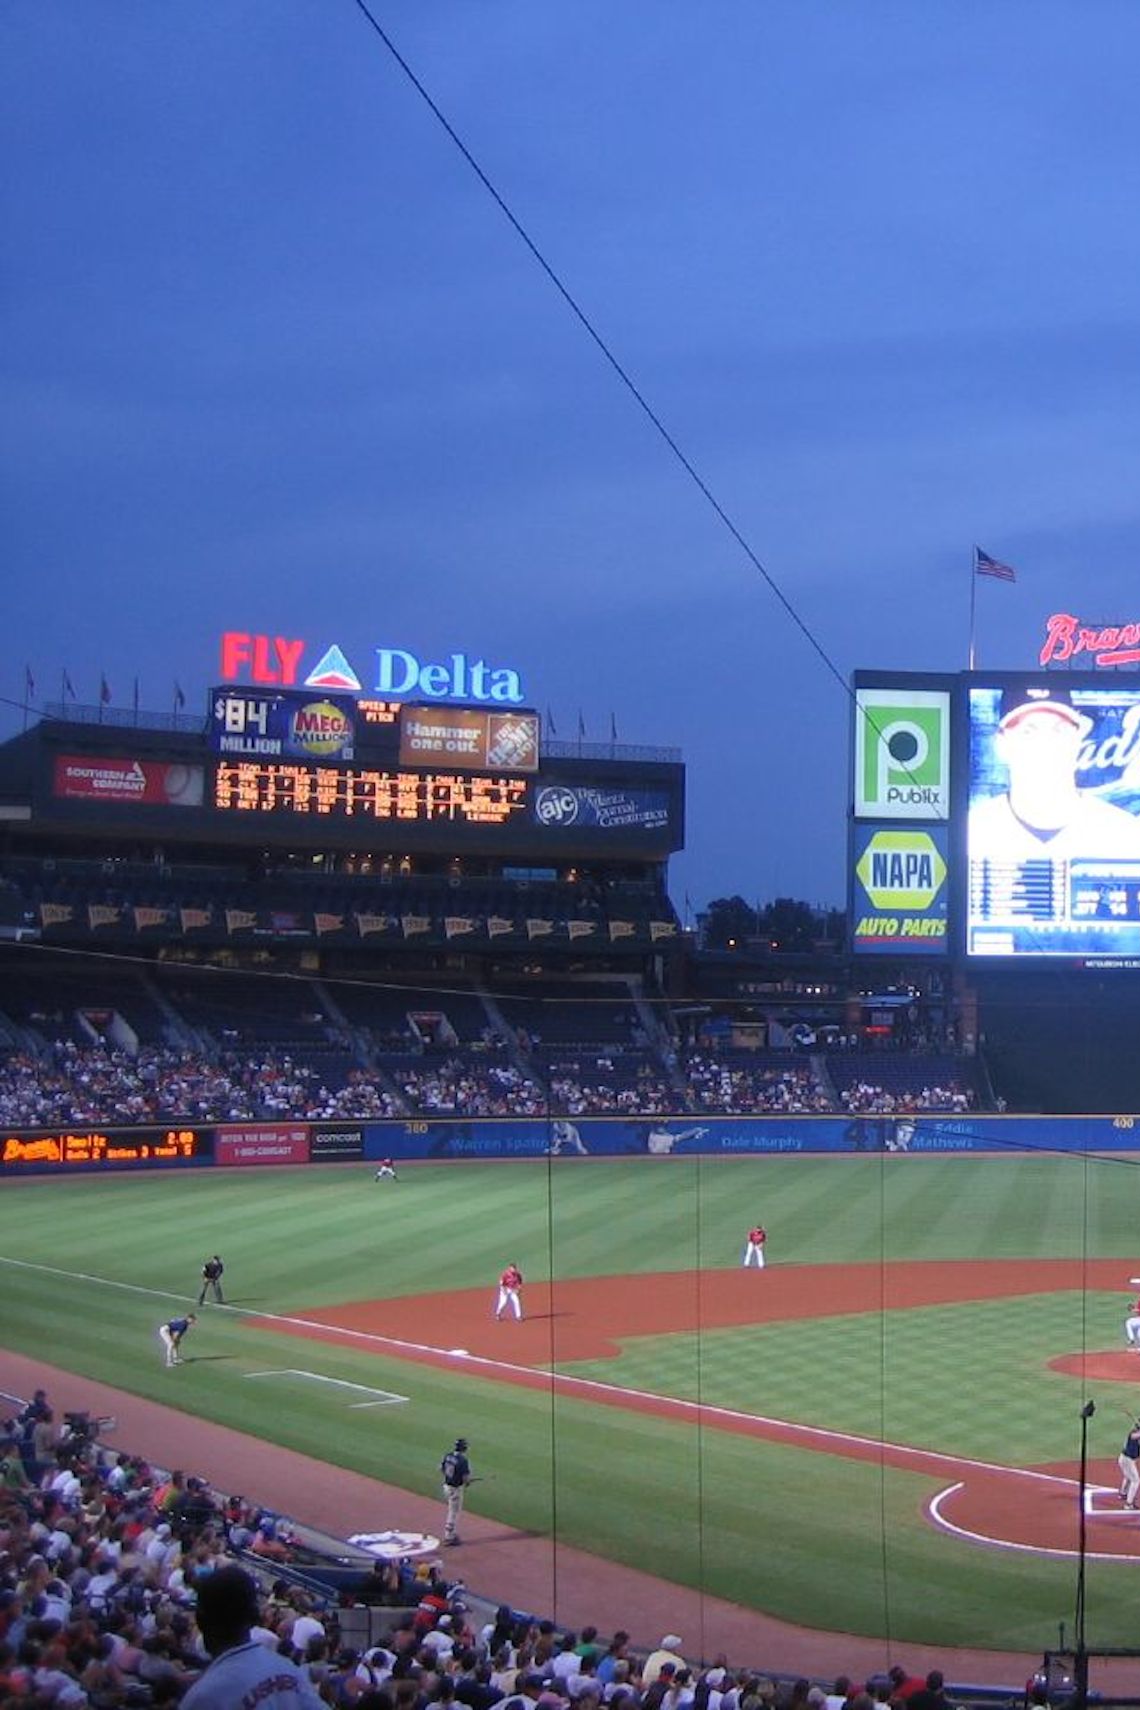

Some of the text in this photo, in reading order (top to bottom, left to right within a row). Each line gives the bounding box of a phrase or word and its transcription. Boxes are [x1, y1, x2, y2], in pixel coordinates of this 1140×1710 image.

[222, 632, 524, 702] FLY Delta
[215, 698, 267, 735] $84
[294, 712, 353, 732] MEGA
[366, 712, 394, 722] PITCH
[406, 722, 481, 739] Hammer
[220, 736, 281, 755] MILLION
[410, 739, 479, 752] one out.
[66, 766, 125, 779] SOUTHERN
[93, 779, 144, 791] COMPANY
[888, 787, 940, 804] Publix
[541, 794, 575, 820] ajc
[872, 852, 932, 888] NAPA
[855, 917, 947, 936] AUTO PARTS
[935, 1123, 973, 1135] Eddie
[1112, 1117, 1134, 1128] 400
[316, 1132, 361, 1143] comcast
[754, 1137, 801, 1151] Murphy
